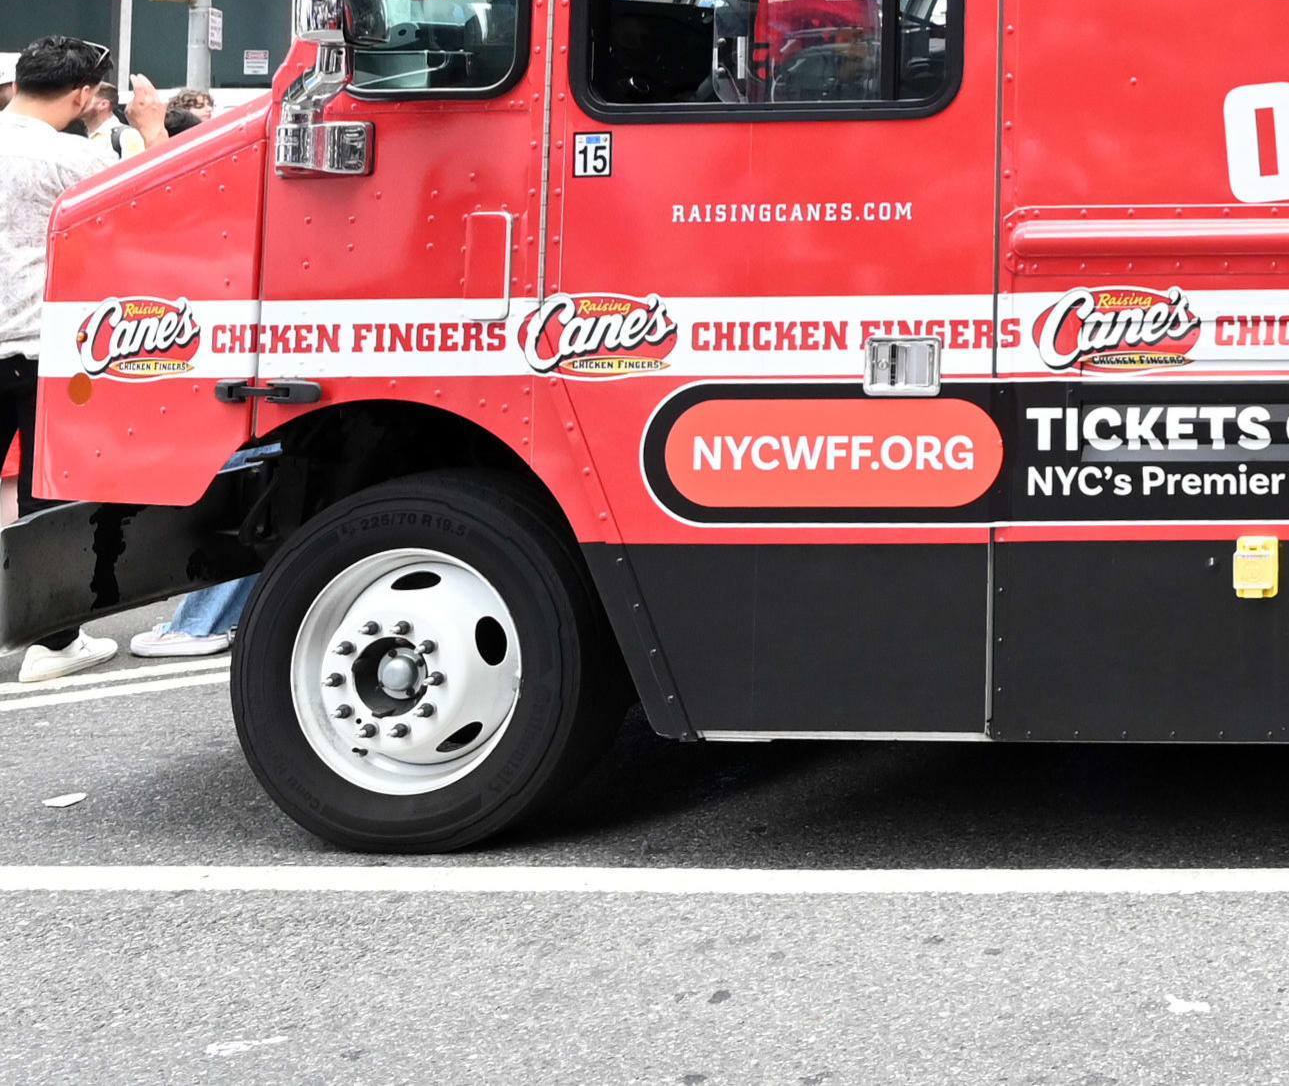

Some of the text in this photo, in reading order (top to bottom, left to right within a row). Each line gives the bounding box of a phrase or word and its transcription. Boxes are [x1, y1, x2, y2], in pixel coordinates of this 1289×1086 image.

[579, 146, 607, 173] 15
[672, 202, 912, 223] RAISINGCANES.COM
[124, 303, 166, 318] Raising
[579, 299, 631, 316] Raising
[1098, 293, 1151, 309] Raising
[81, 298, 200, 375] Cane's
[352, 322, 507, 352] FINGERS
[525, 293, 678, 375] Cane's
[691, 320, 847, 351] CHICKEN
[1039, 286, 1200, 370] Cane's
[119, 361, 187, 371] CHICKEN FINGERS
[573, 360, 661, 370] CHICKEN FINGERS
[1026, 406, 1270, 451] TICKETS
[692, 435, 974, 473] NYCWFF.ORG
[1026, 465, 1134, 499] NYC's
[1141, 463, 1286, 496] Premier
